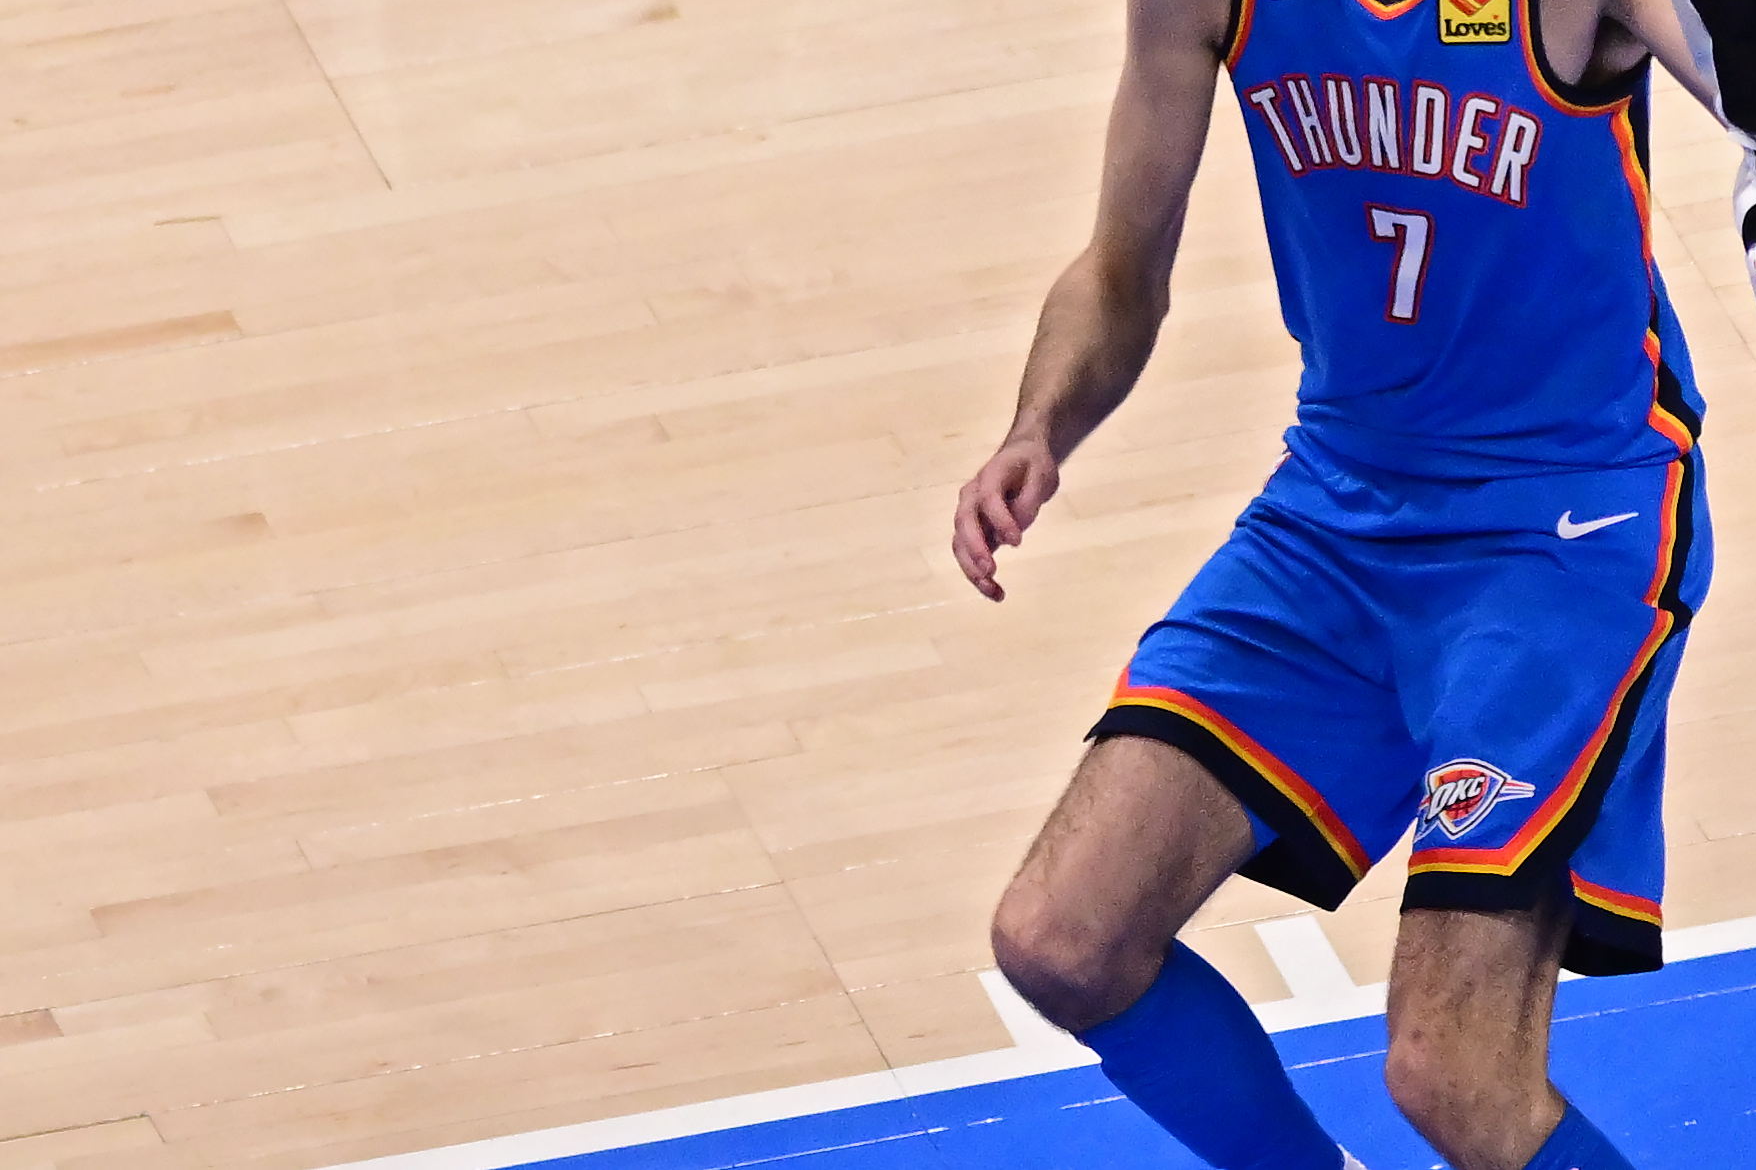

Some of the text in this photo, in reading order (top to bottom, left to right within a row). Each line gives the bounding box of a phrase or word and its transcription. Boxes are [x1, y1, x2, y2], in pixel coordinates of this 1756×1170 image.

[1246, 73, 1543, 208] THUNDER
[1366, 203, 1435, 324] 7
[1427, 777, 1485, 821] OKC
